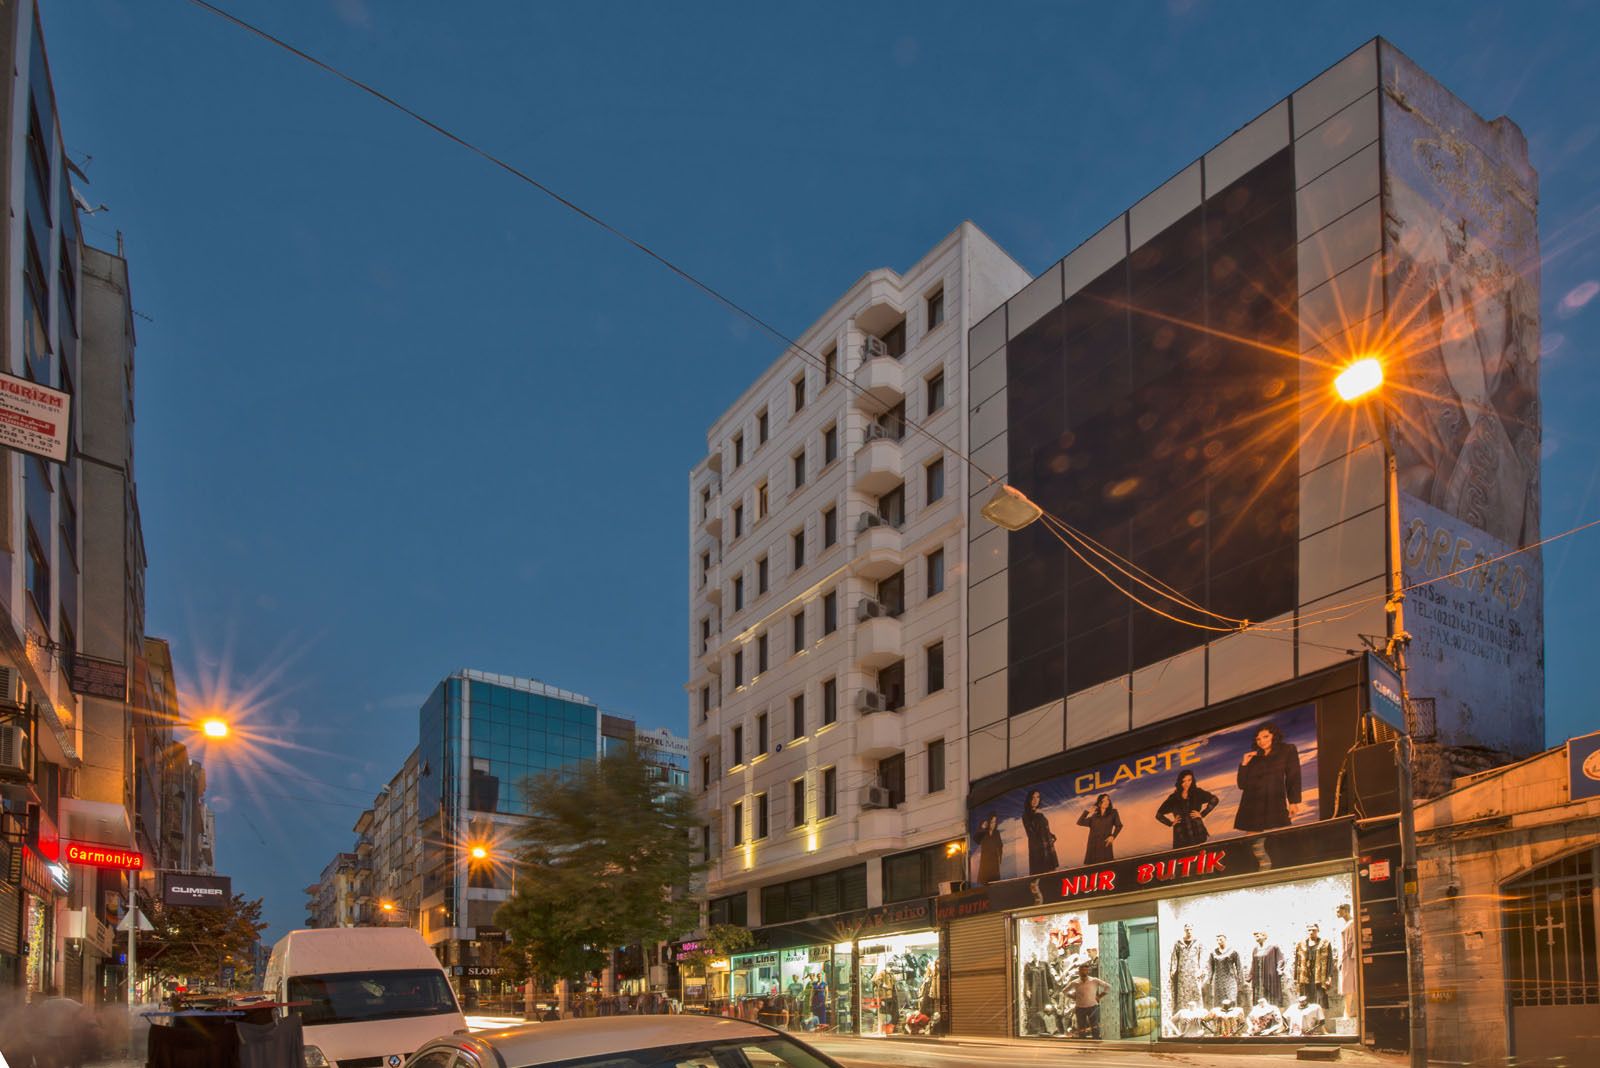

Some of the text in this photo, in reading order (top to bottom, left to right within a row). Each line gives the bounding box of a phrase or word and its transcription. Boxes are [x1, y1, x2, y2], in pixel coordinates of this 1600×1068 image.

[1075, 743, 1201, 795] CLARTE
[69, 847, 141, 867] Garmoniya
[1061, 850, 1227, 897] NUR BUTİK
[171, 886, 223, 895] CLIMBER
[959, 900, 989, 915] BUTİK
